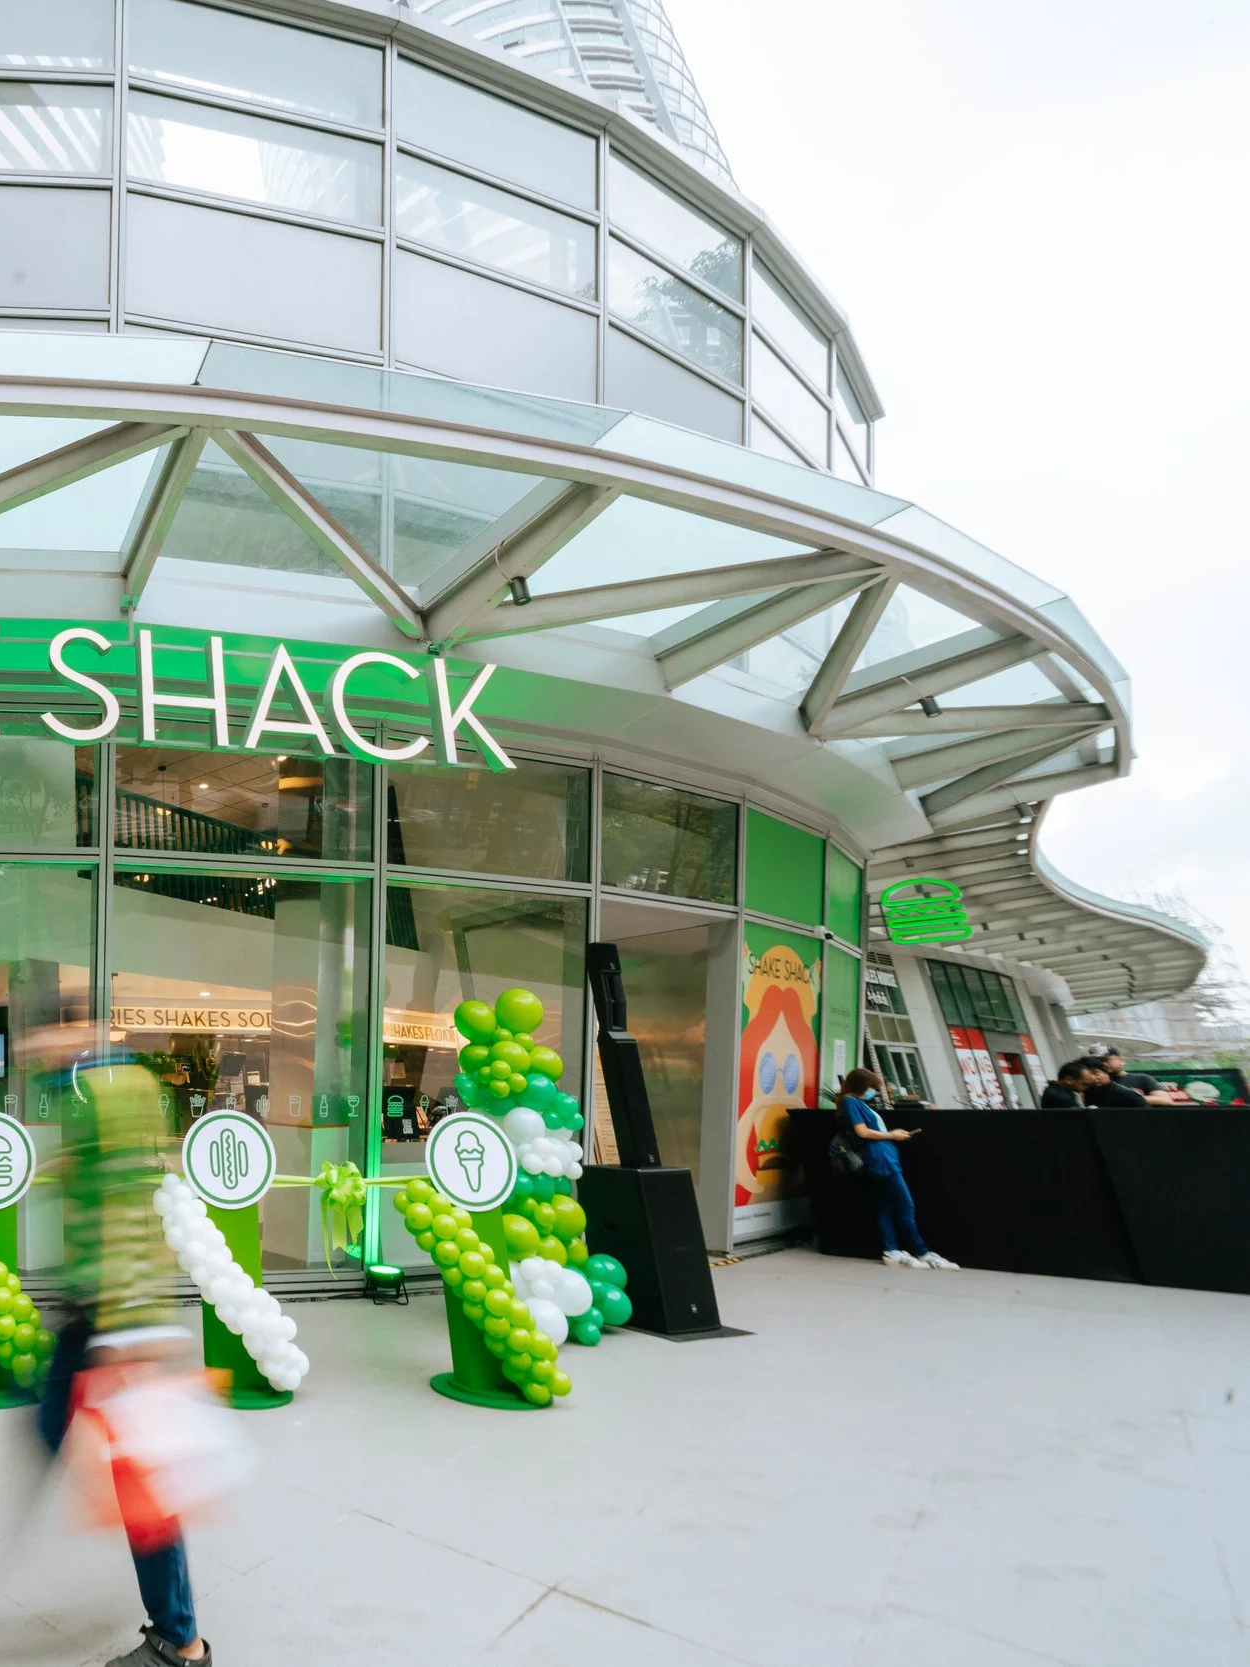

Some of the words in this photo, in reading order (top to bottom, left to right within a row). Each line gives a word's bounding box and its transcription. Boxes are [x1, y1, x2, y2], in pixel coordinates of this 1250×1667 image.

[40, 628, 517, 771] SHACK
[748, 953, 781, 979] SHAKE
[783, 960, 815, 985] SHACK
[154, 1009, 231, 1028] SHAKES
[391, 1023, 424, 1040] HAKES
